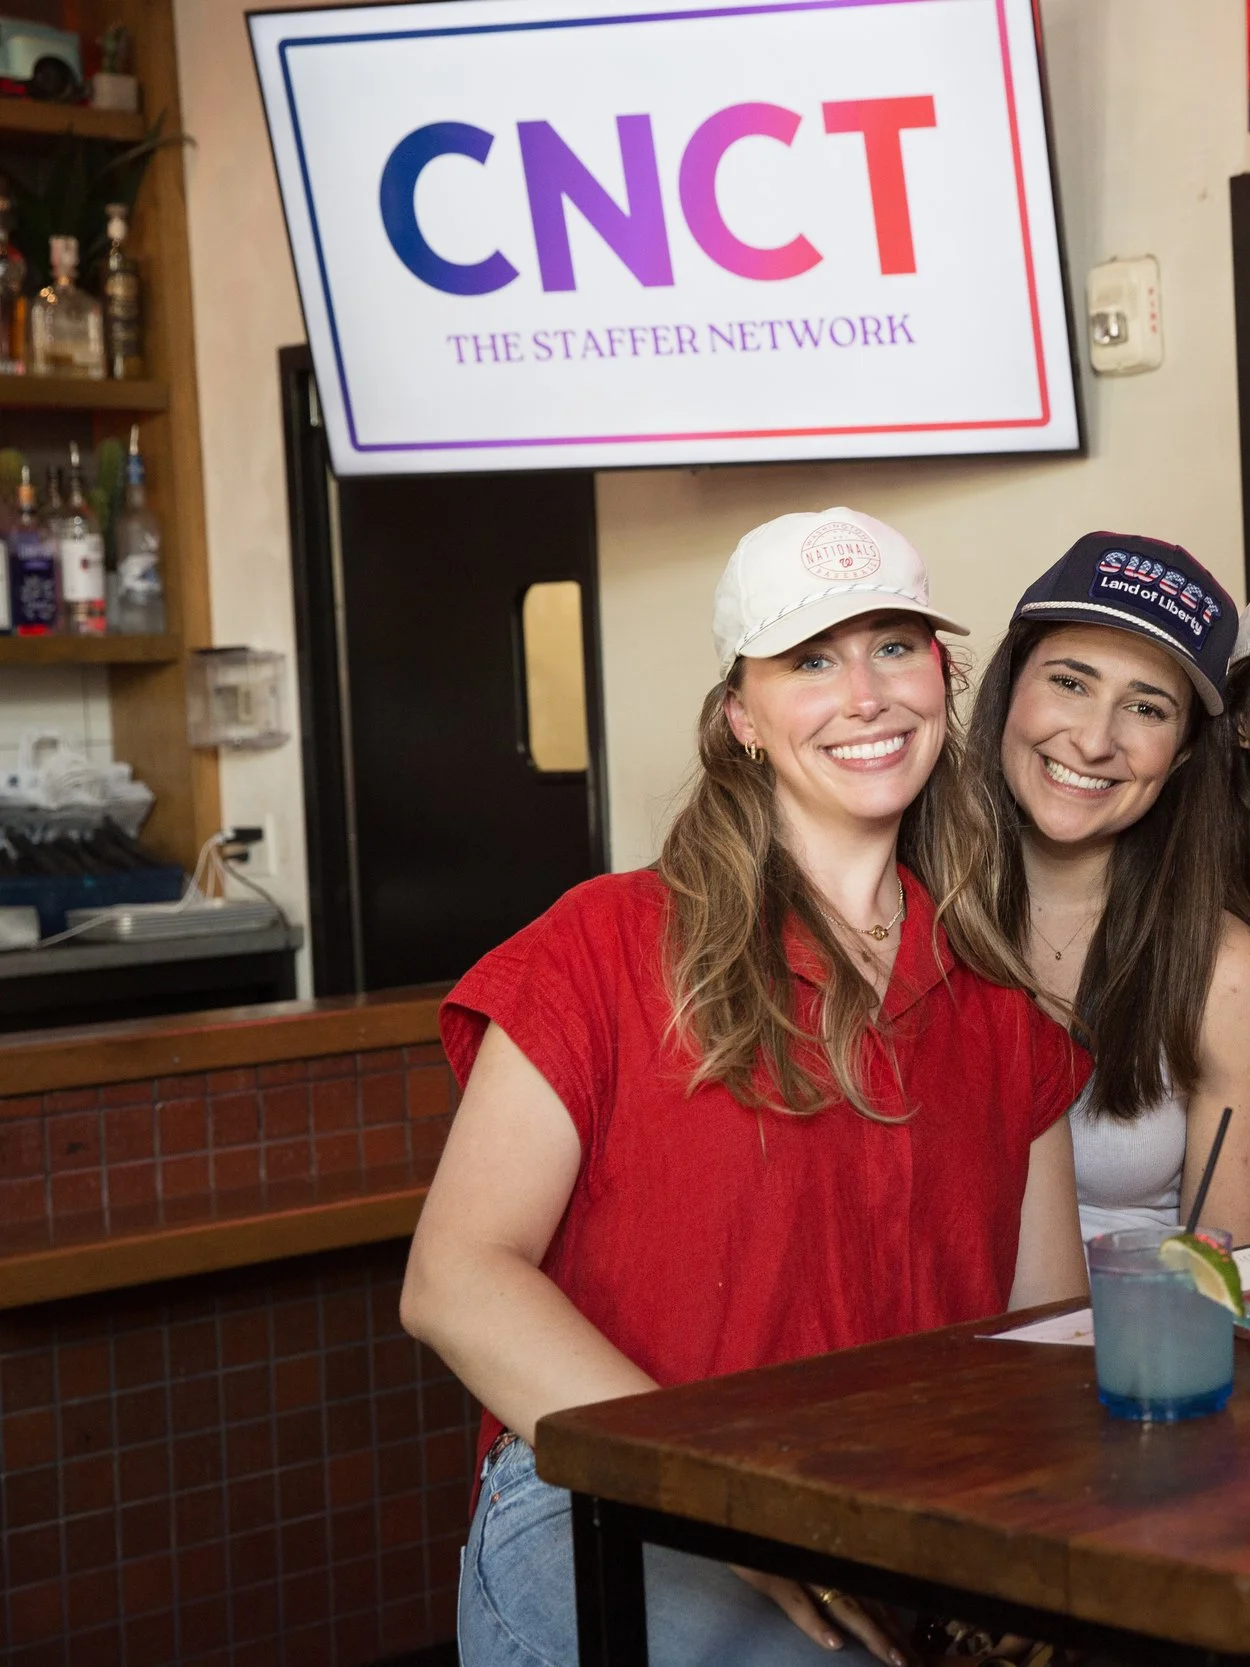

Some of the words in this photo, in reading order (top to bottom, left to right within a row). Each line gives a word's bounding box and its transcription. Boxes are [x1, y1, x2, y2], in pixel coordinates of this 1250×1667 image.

[380, 93, 937, 296] CNCT
[446, 333, 525, 364] THE
[532, 323, 700, 362] STAFFER
[708, 313, 917, 353] NETWORK
[805, 543, 877, 565] NATIONALS
[1099, 551, 1219, 624] SWEET
[1100, 576, 1140, 595] Land
[1140, 589, 1159, 602] of
[1158, 596, 1203, 636] Liberty
